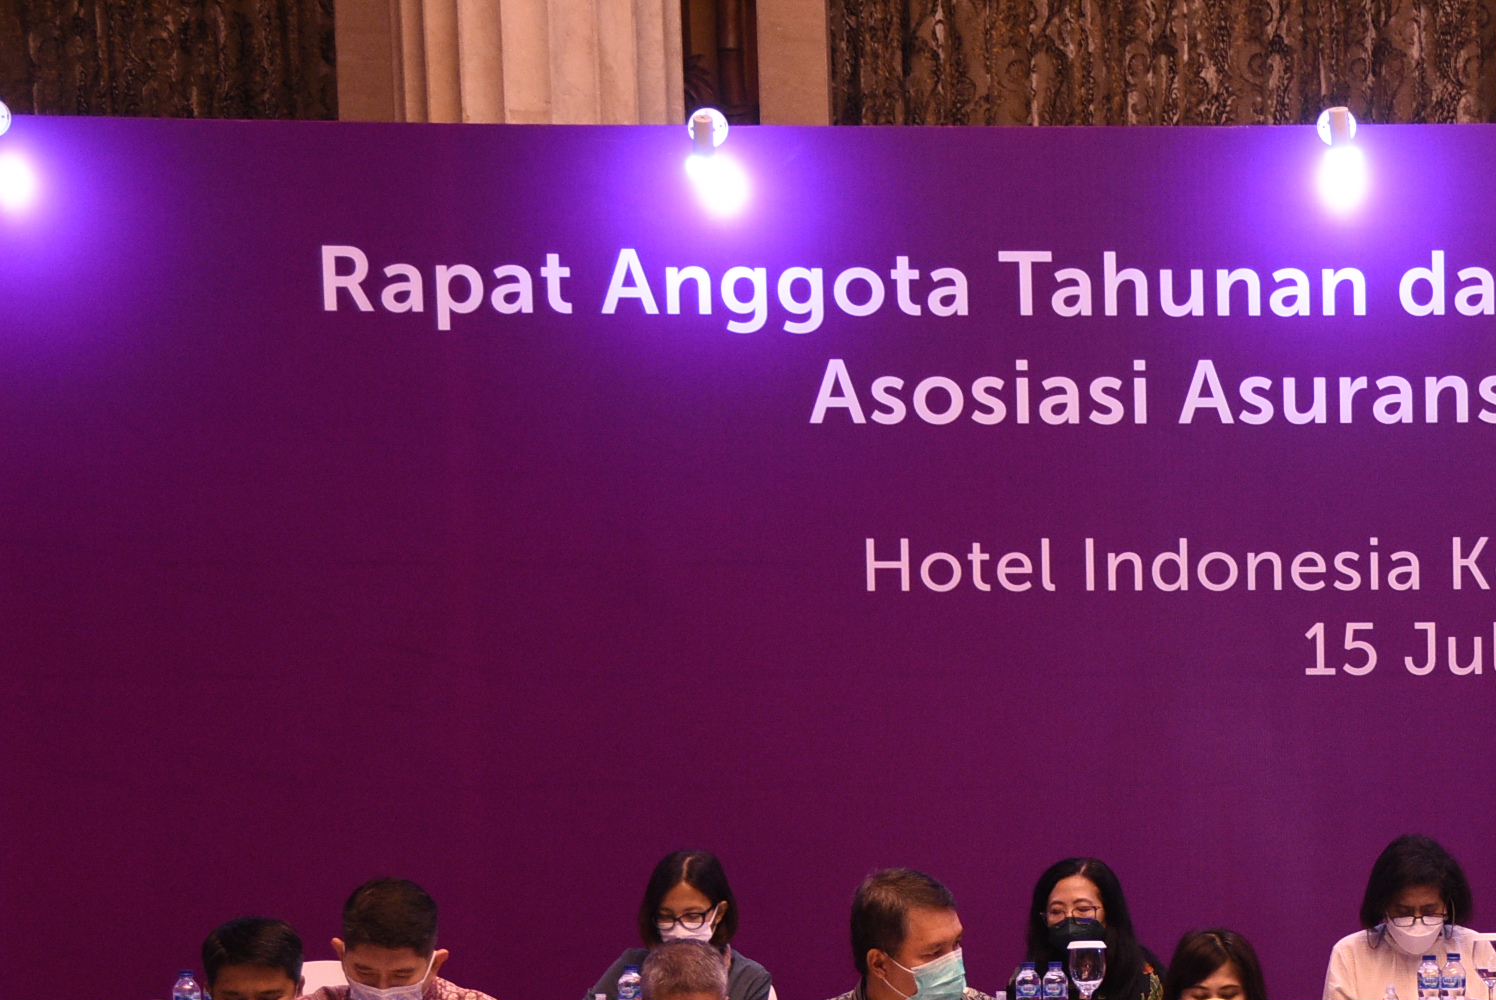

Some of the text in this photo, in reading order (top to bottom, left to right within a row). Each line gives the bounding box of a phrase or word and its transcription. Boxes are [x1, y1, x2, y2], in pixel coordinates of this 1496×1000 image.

[322, 245, 573, 331] Rapat
[602, 248, 970, 335] Anggota
[998, 248, 1370, 319] Tahunan
[809, 357, 1147, 426] Asosiasi
[866, 537, 1056, 593] Hotel
[1085, 537, 1420, 593] Indonesia
[1305, 621, 1377, 677] 15
